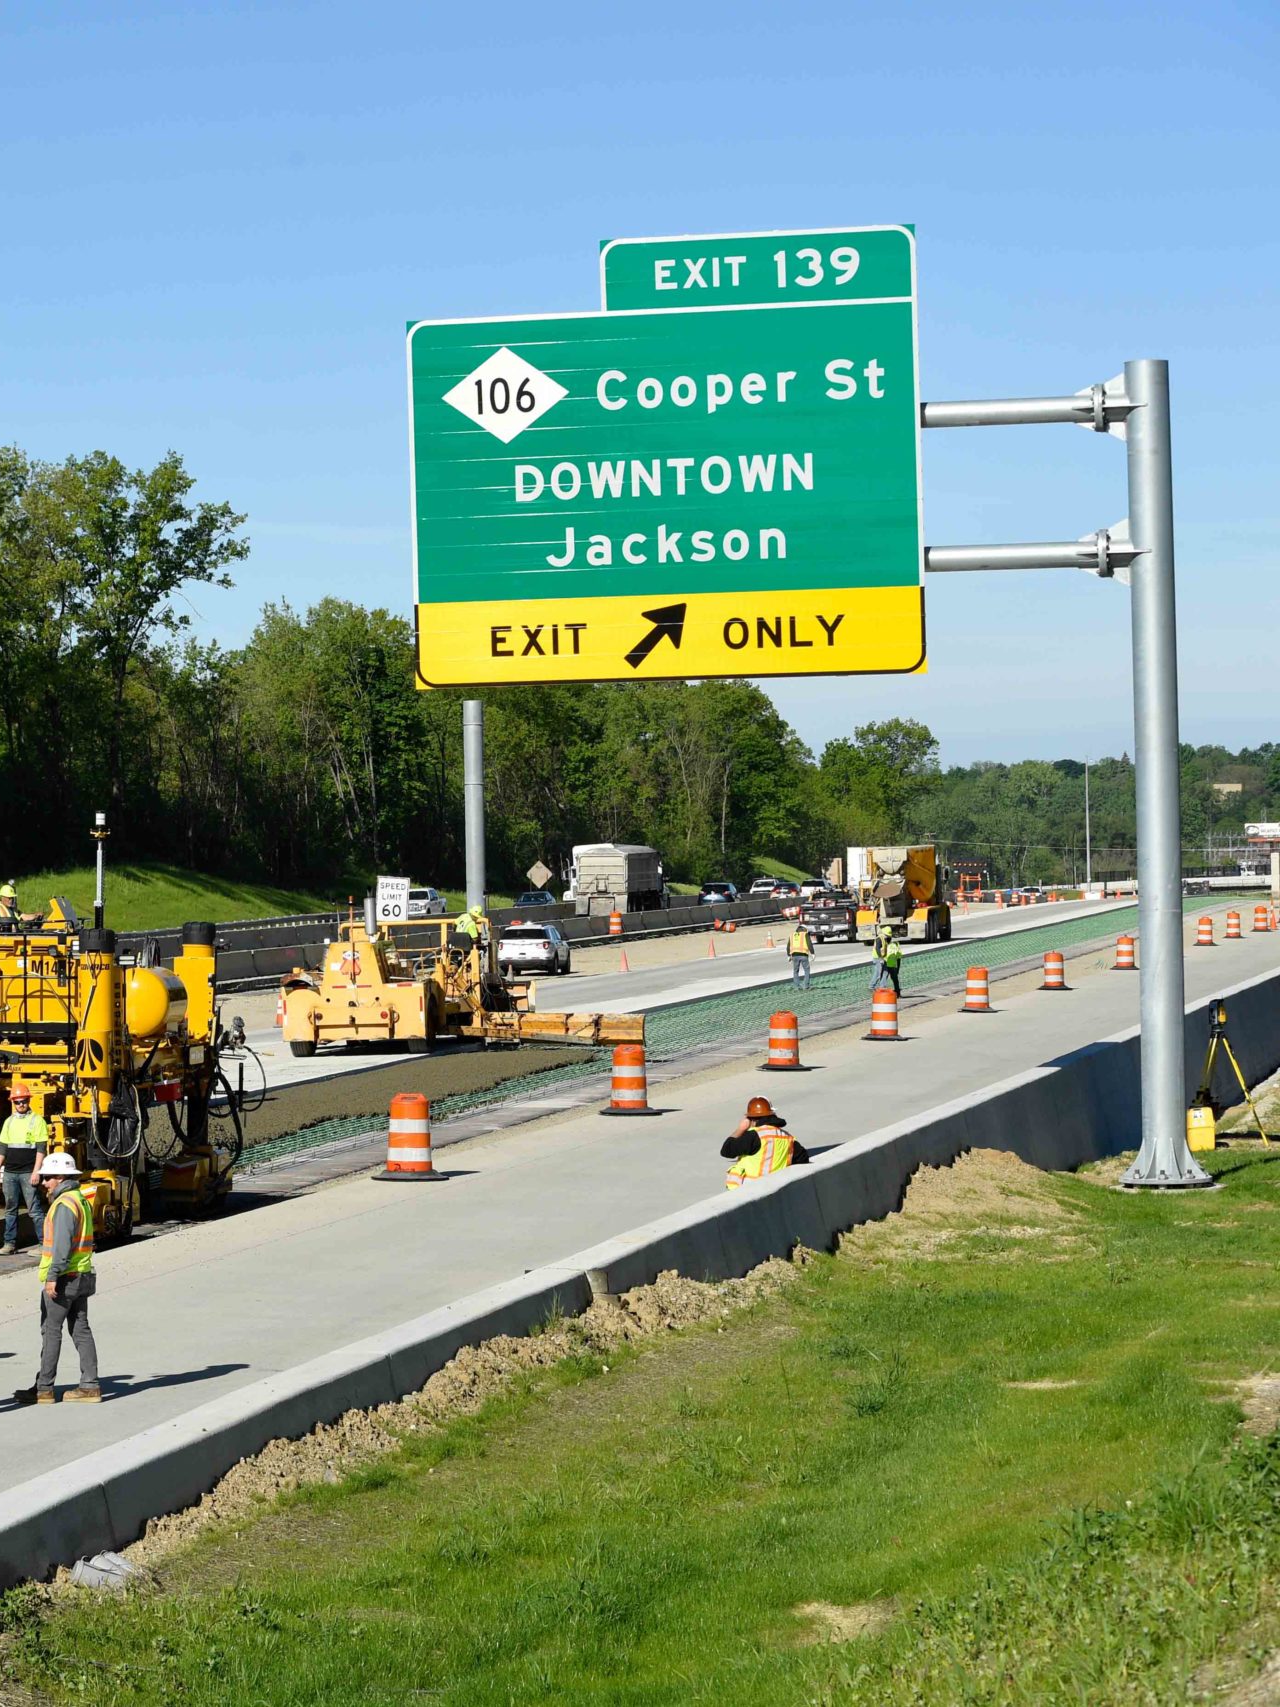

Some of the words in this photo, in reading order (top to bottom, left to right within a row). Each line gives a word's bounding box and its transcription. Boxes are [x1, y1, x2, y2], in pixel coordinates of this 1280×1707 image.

[654, 256, 747, 290] EXIT
[773, 246, 861, 288] 139
[473, 376, 536, 415] 106
[596, 369, 797, 413] Cooper
[824, 357, 886, 400] St
[514, 452, 815, 502] DOWNTOWN
[545, 522, 787, 568] Jackson
[490, 622, 588, 657] EXIT
[723, 613, 846, 650] ONLY
[380, 882, 406, 890] SPEED
[382, 904, 401, 917] 60
[31, 959, 75, 976] M147
